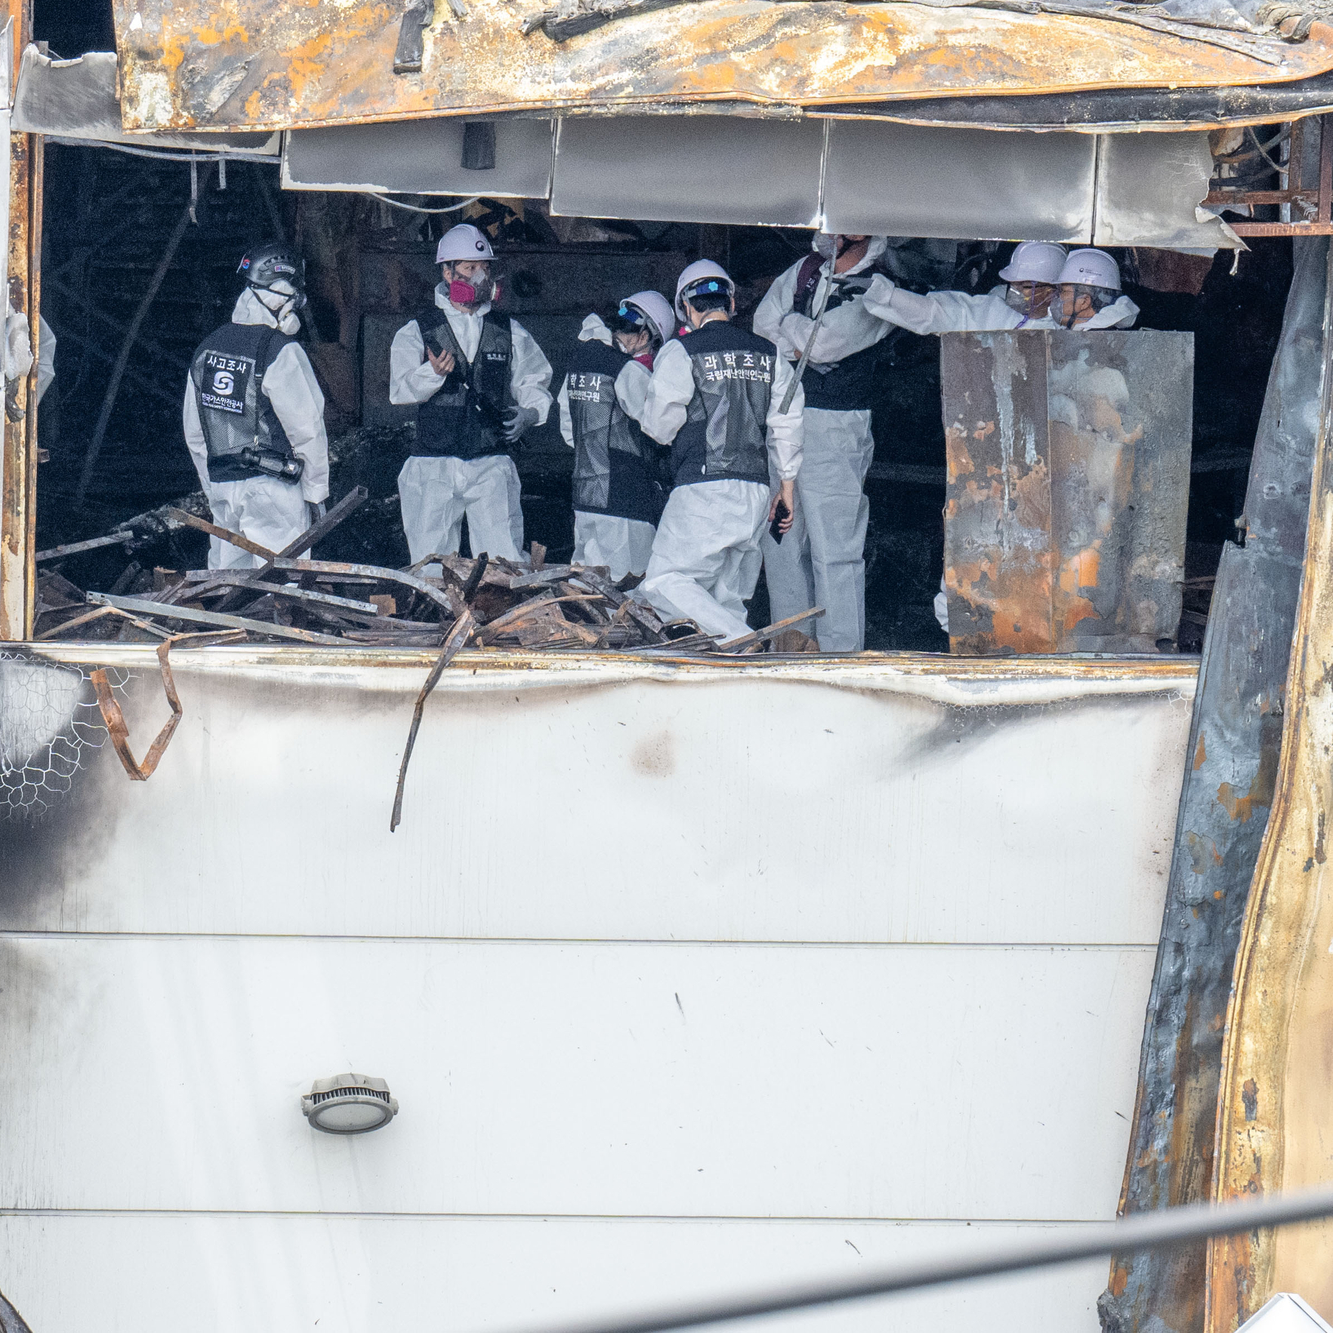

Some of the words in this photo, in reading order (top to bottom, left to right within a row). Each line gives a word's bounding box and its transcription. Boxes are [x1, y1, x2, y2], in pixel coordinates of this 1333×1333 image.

[207, 355, 247, 374] 사고조사
[704, 352, 771, 371] 과학조사
[570, 373, 601, 391] 학조사
